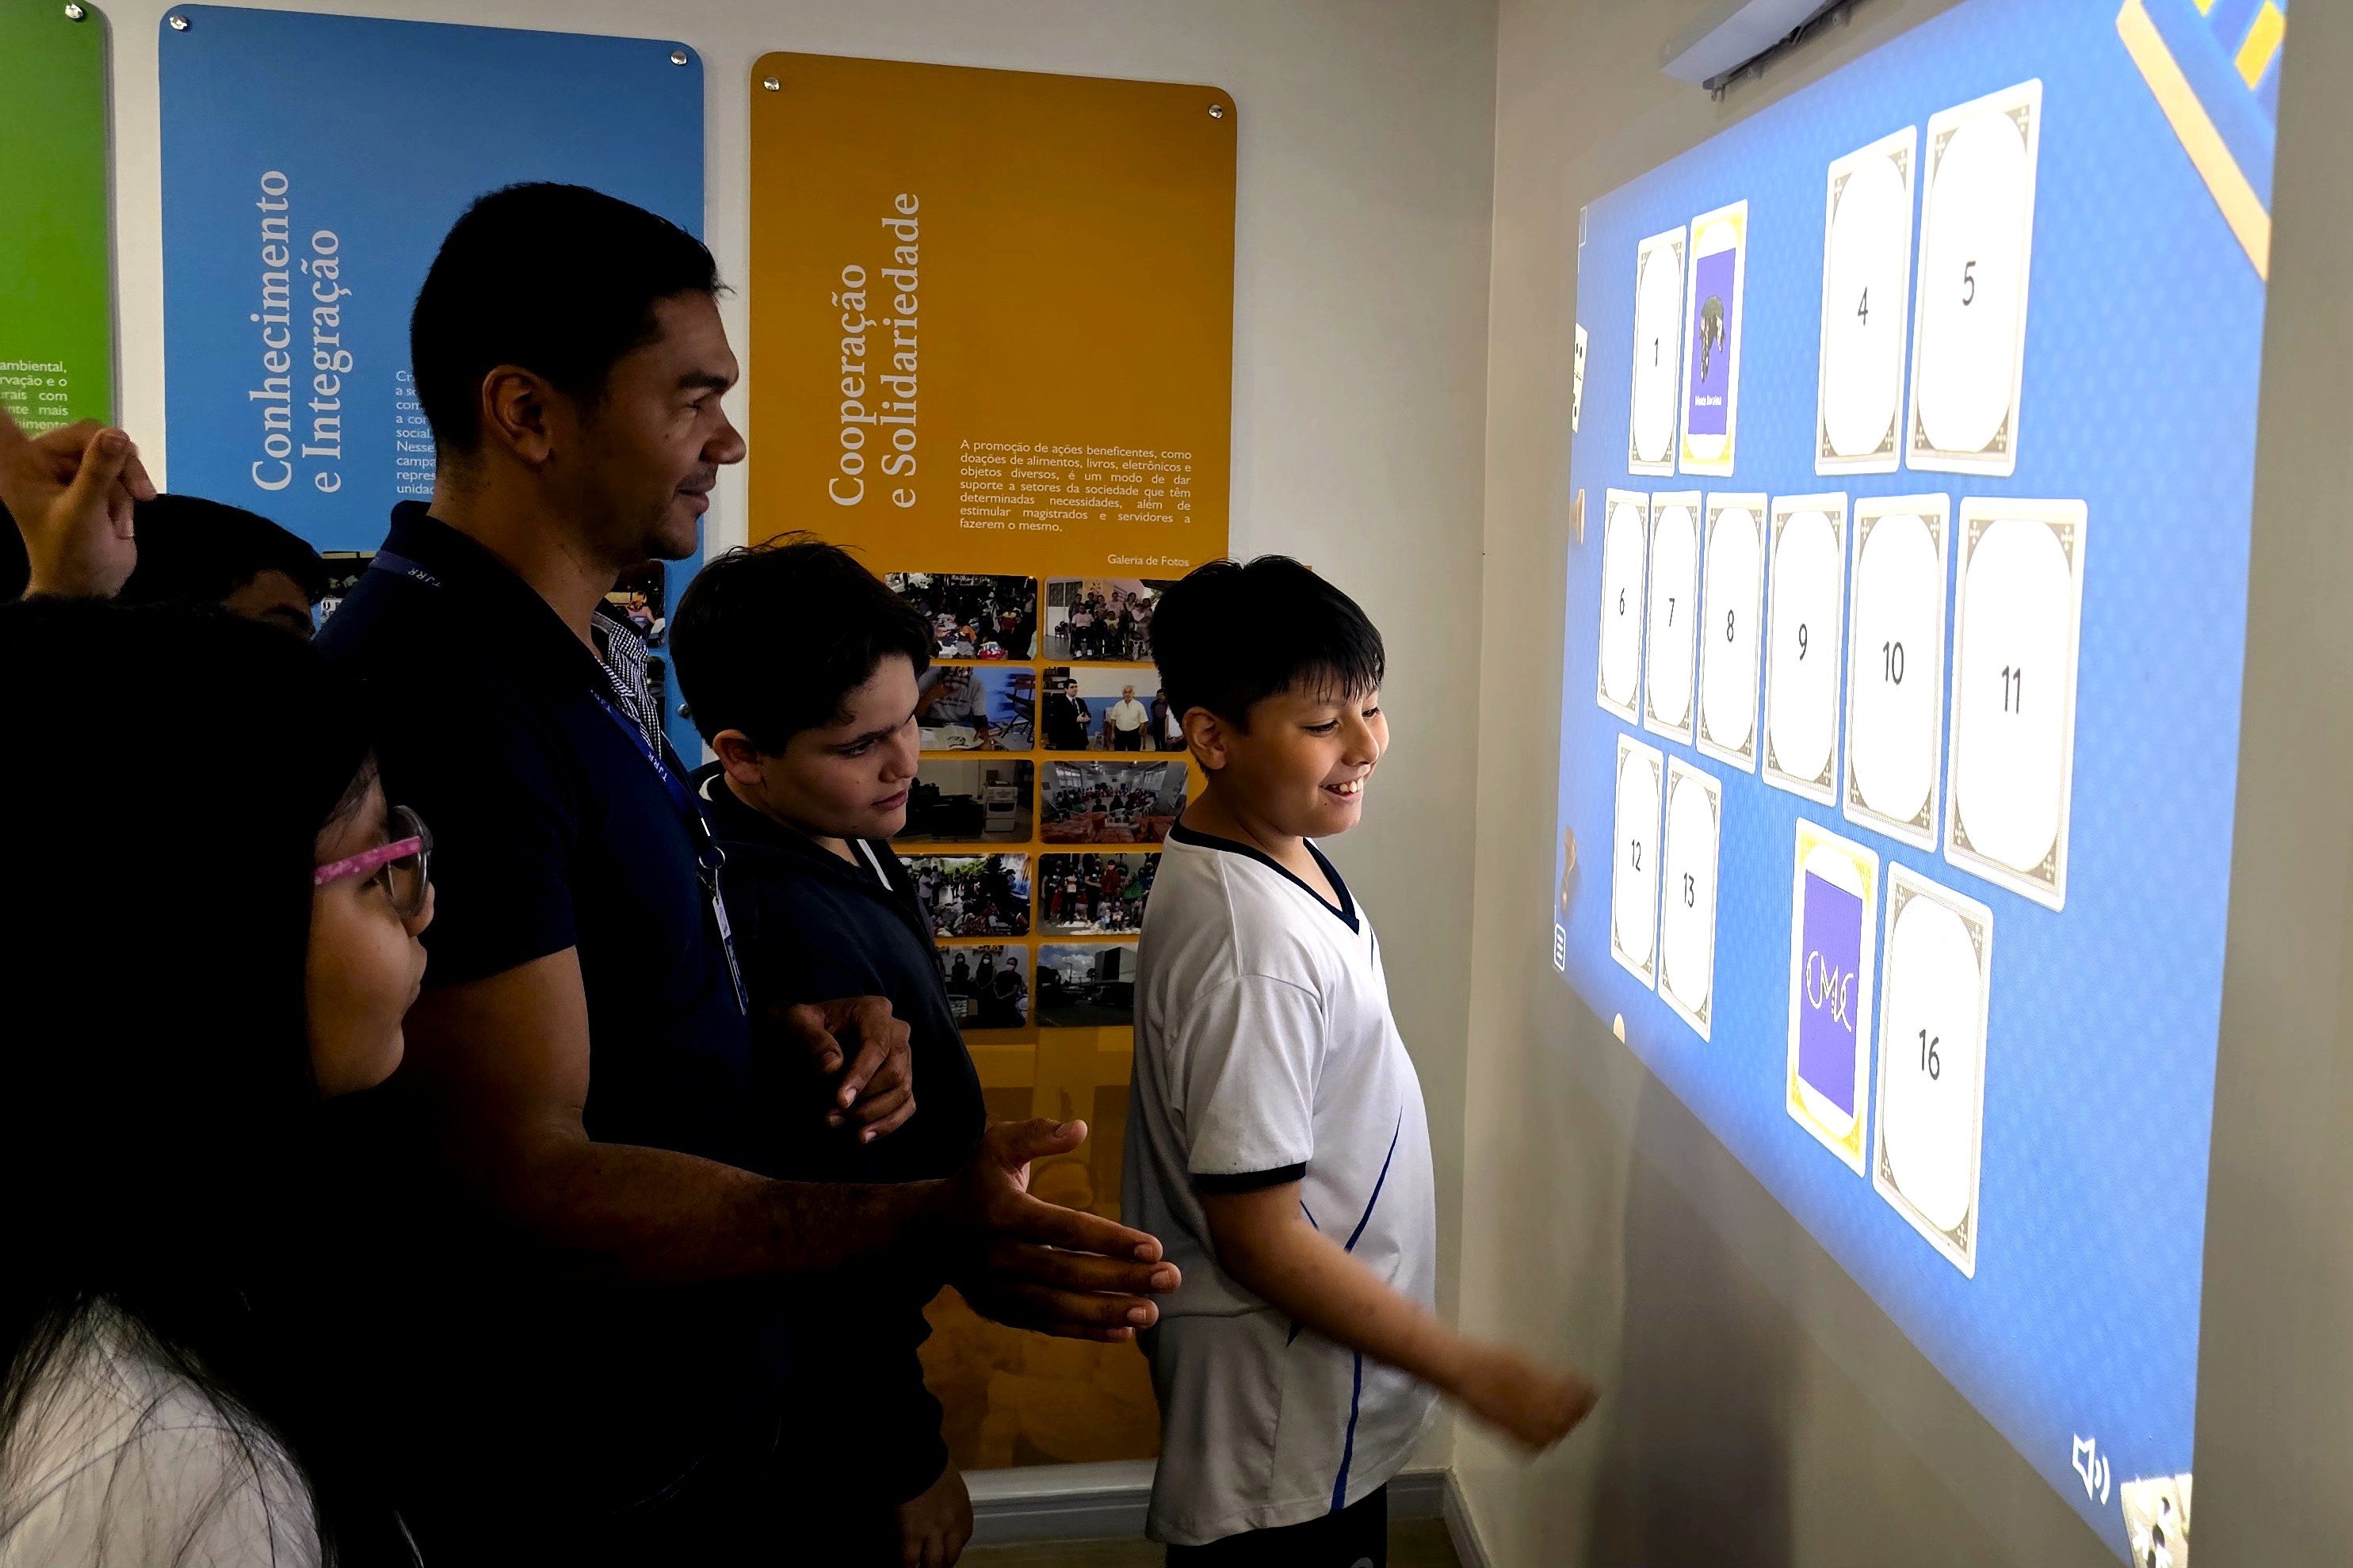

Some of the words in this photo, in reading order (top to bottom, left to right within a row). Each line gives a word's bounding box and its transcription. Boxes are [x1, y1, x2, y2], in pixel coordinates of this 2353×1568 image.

[1962, 261, 1976, 306] 5
[1857, 287, 1869, 326] 4
[249, 170, 292, 491] Conhecimento
[301, 229, 353, 460] Integração
[880, 193, 919, 477] Solidariedade
[1653, 338, 1659, 368] 1
[38, 392, 68, 402] com
[46, 378, 55, 387] e
[58, 378, 68, 387] o
[395, 387, 403, 396] a
[828, 264, 877, 506] Cooperação
[38, 405, 69, 416] mais
[960, 439, 970, 449] A
[973, 442, 1031, 454] promoção
[1034, 443, 1049, 452] de
[1052, 444, 1083, 456] ações
[1087, 445, 1158, 459] beneficentes,
[1161, 450, 1192, 460] como
[960, 452, 1007, 466] doações
[1010, 455, 1024, 465] de
[1027, 456, 1083, 468] alimentos,
[1087, 458, 1119, 470] livros,
[1122, 460, 1182, 471] eletrônicos
[315, 471, 342, 493] e
[960, 466, 1002, 479] objetos
[1010, 468, 1060, 480] diversos,
[1068, 471, 1075, 480] é
[1110, 473, 1143, 483] modo
[1151, 475, 1166, 484] de
[1173, 475, 1191, 485] dar
[960, 481, 1003, 492] suporte
[1020, 483, 1061, 492] setores
[1066, 483, 1079, 494] da
[1085, 485, 1139, 496] sociedade
[1144, 488, 1164, 499] que
[1170, 487, 1191, 498] têm
[892, 487, 916, 509] e
[960, 492, 1035, 505] determinadas
[1049, 497, 1123, 509] necessidades,
[1136, 498, 1163, 509] além
[1177, 501, 1191, 510] de
[960, 505, 1010, 517] estimular
[1022, 508, 1088, 521] magistrados
[1117, 511, 1174, 523] servidores
[960, 517, 1004, 529] fazerem
[1018, 522, 1063, 532] mesmo.
[1107, 554, 1144, 565] Galeria
[1145, 555, 1159, 566] de
[1161, 556, 1190, 567] Fotos
[1619, 587, 1625, 616] 6
[1667, 597, 1675, 627] 7
[1726, 609, 1735, 643] 8
[1798, 623, 1808, 662] 9
[1882, 641, 1904, 686] 10
[2001, 666, 2021, 714] 11
[647, 750, 668, 783] TJRR
[1630, 839, 1641, 872] 12
[1683, 872, 1694, 909] 13
[1919, 1028, 1940, 1081] 16
